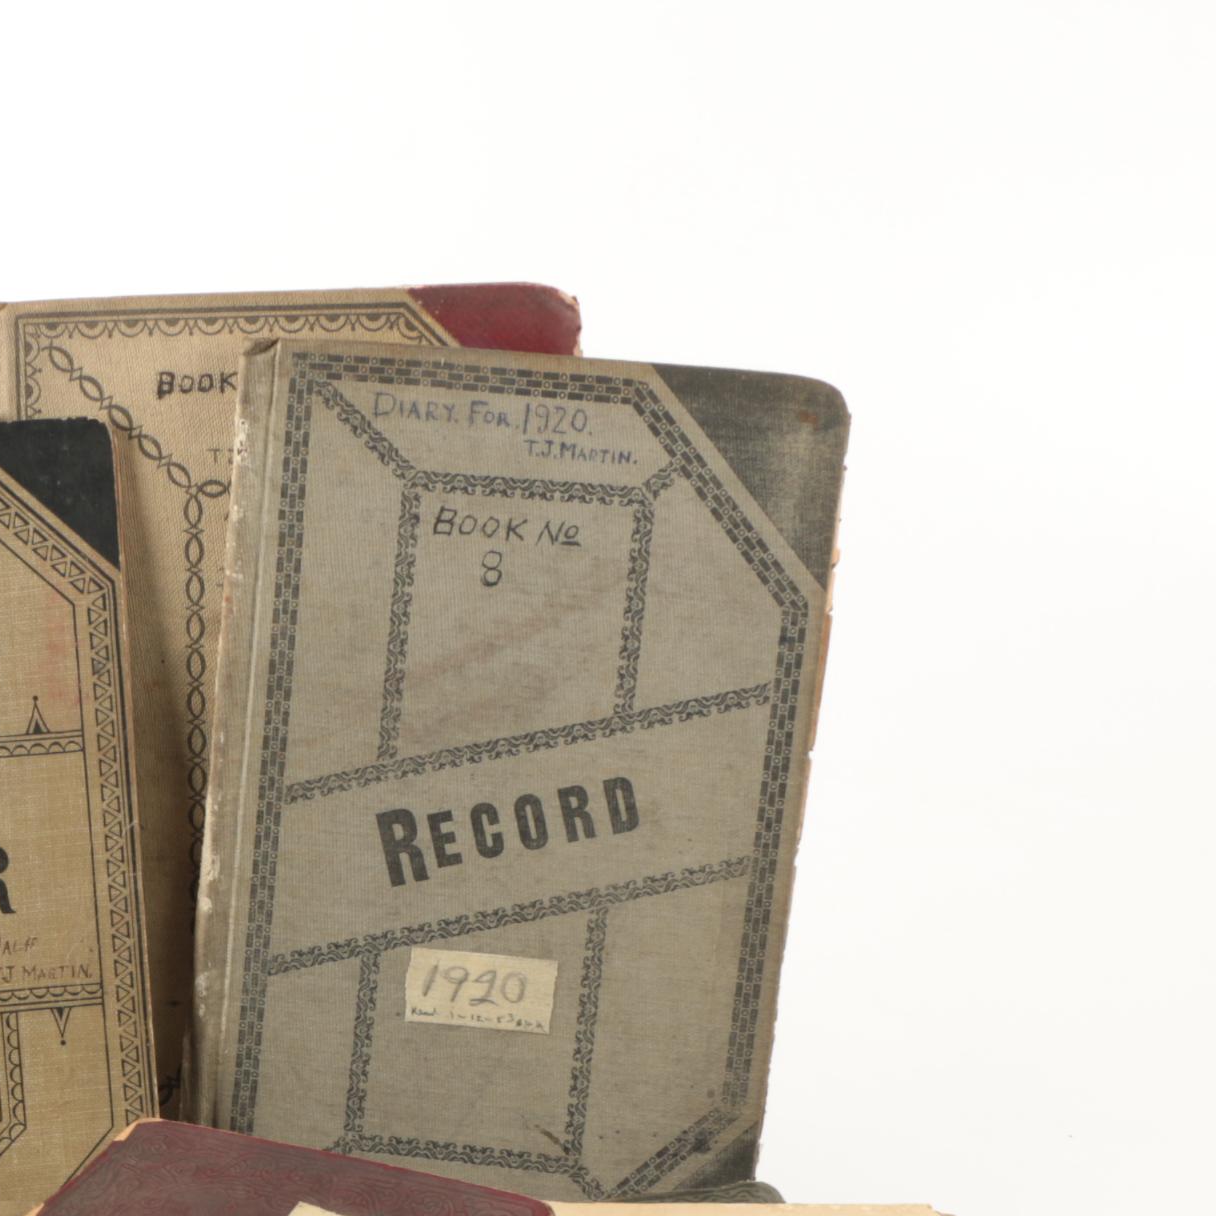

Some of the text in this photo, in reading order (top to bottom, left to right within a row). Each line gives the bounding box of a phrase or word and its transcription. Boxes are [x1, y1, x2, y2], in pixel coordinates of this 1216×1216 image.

[434, 506, 527, 541] BOOK
[481, 551, 502, 587] 8
[376, 777, 639, 887] RECORD
[422, 961, 527, 1006] 1920
